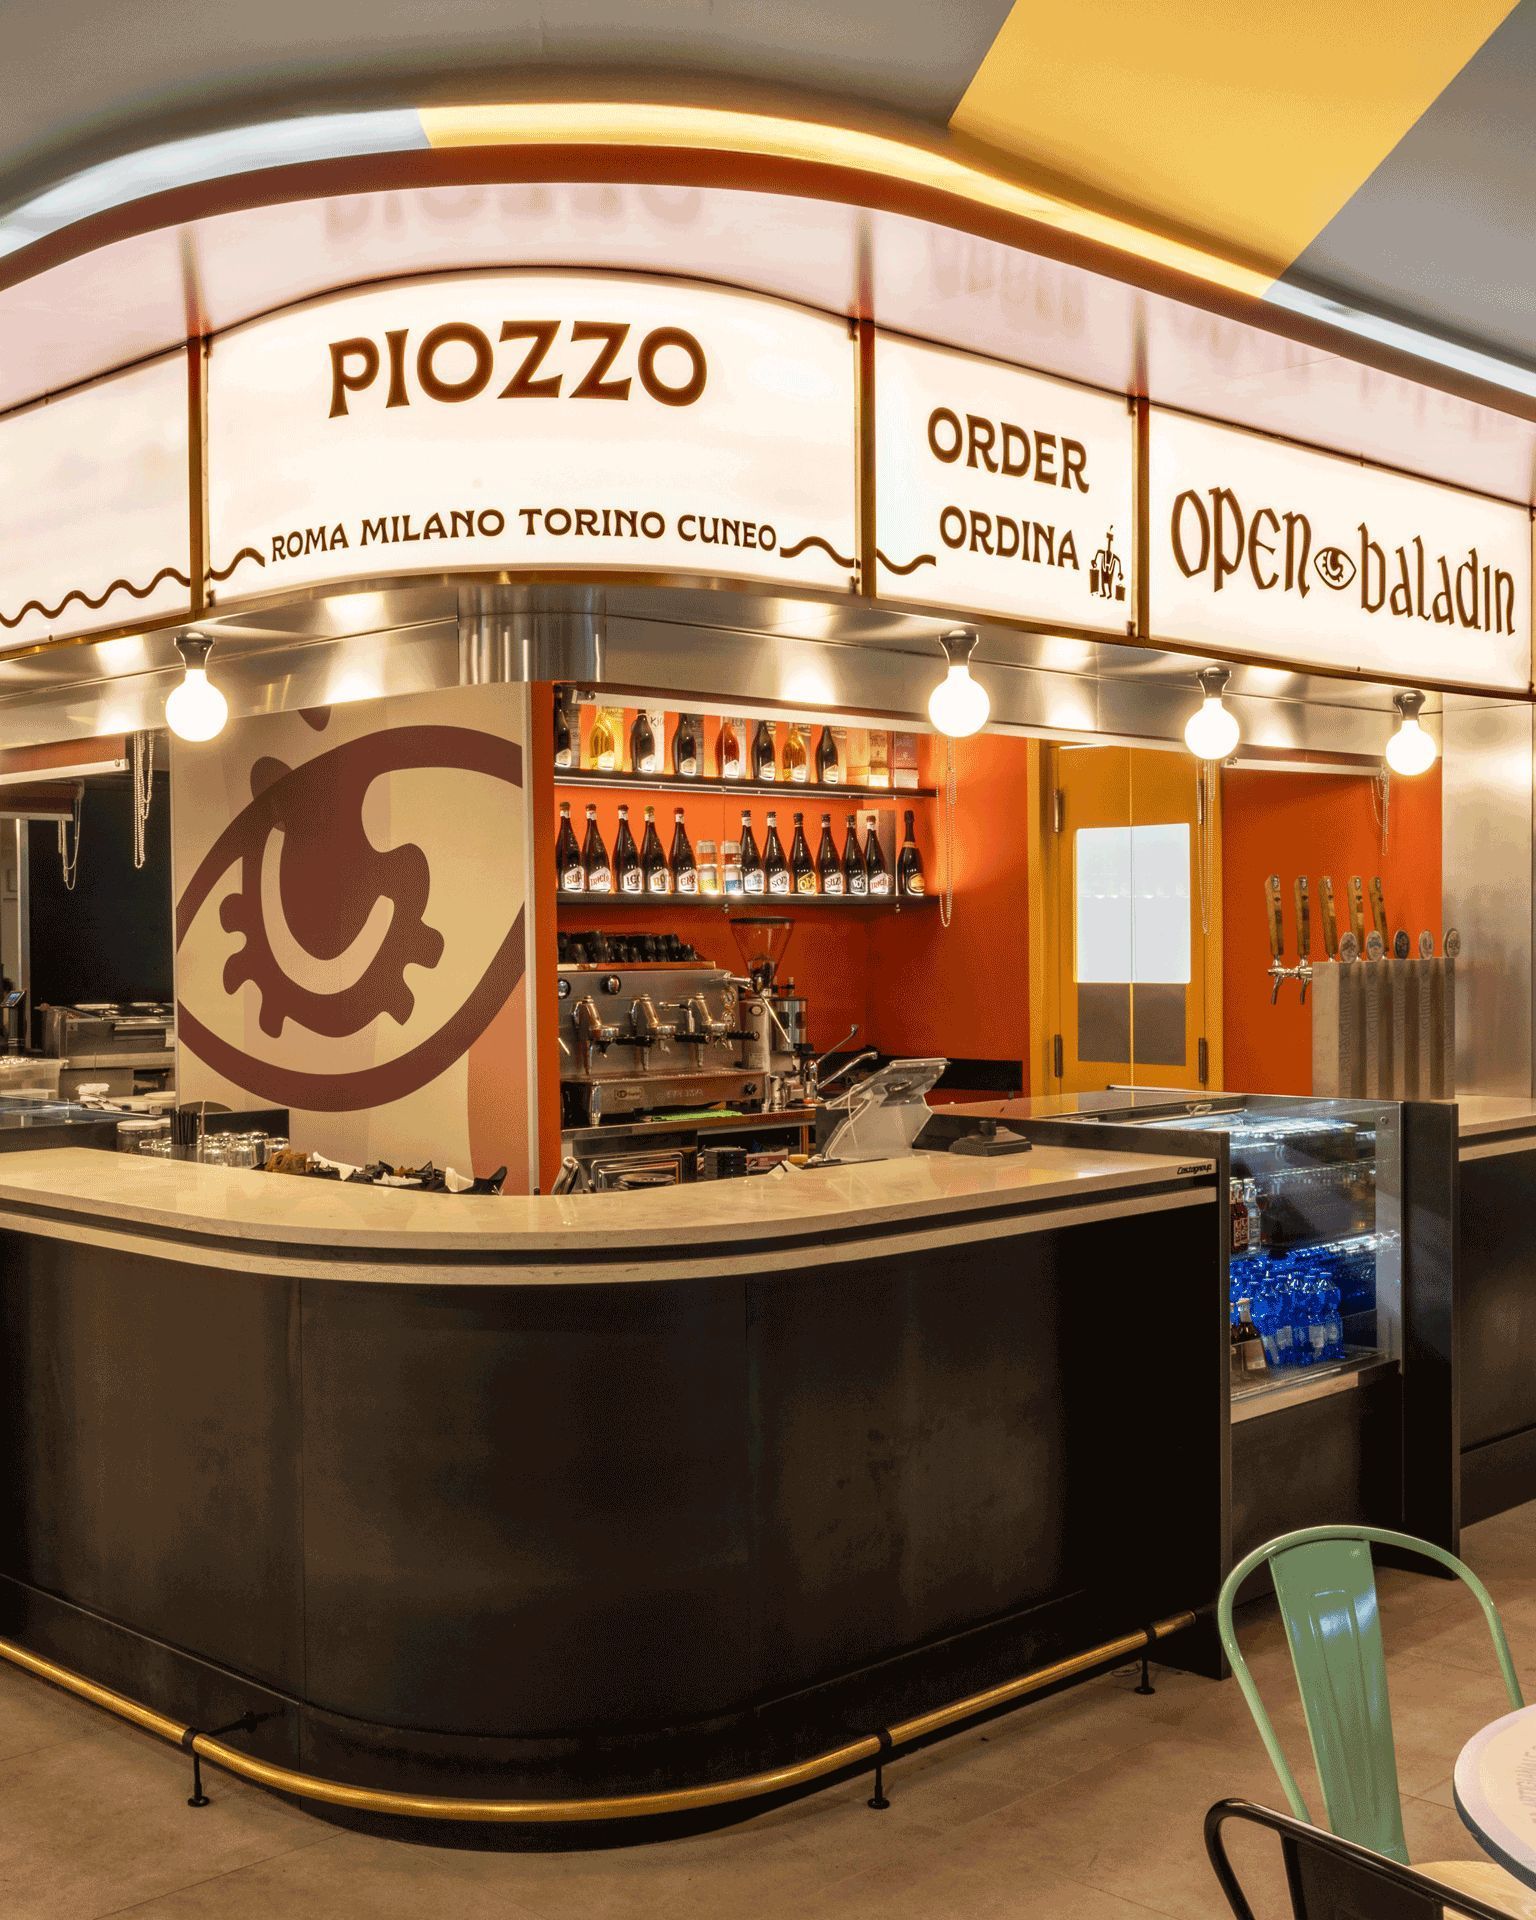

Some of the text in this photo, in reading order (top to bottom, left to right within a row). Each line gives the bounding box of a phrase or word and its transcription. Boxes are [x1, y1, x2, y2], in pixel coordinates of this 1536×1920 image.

[328, 320, 707, 419] PIOZZO
[927, 407, 1091, 494] ORDER
[271, 508, 777, 563] ROMA MILANO TORINO CUNEO
[939, 505, 1080, 571] ORDINA
